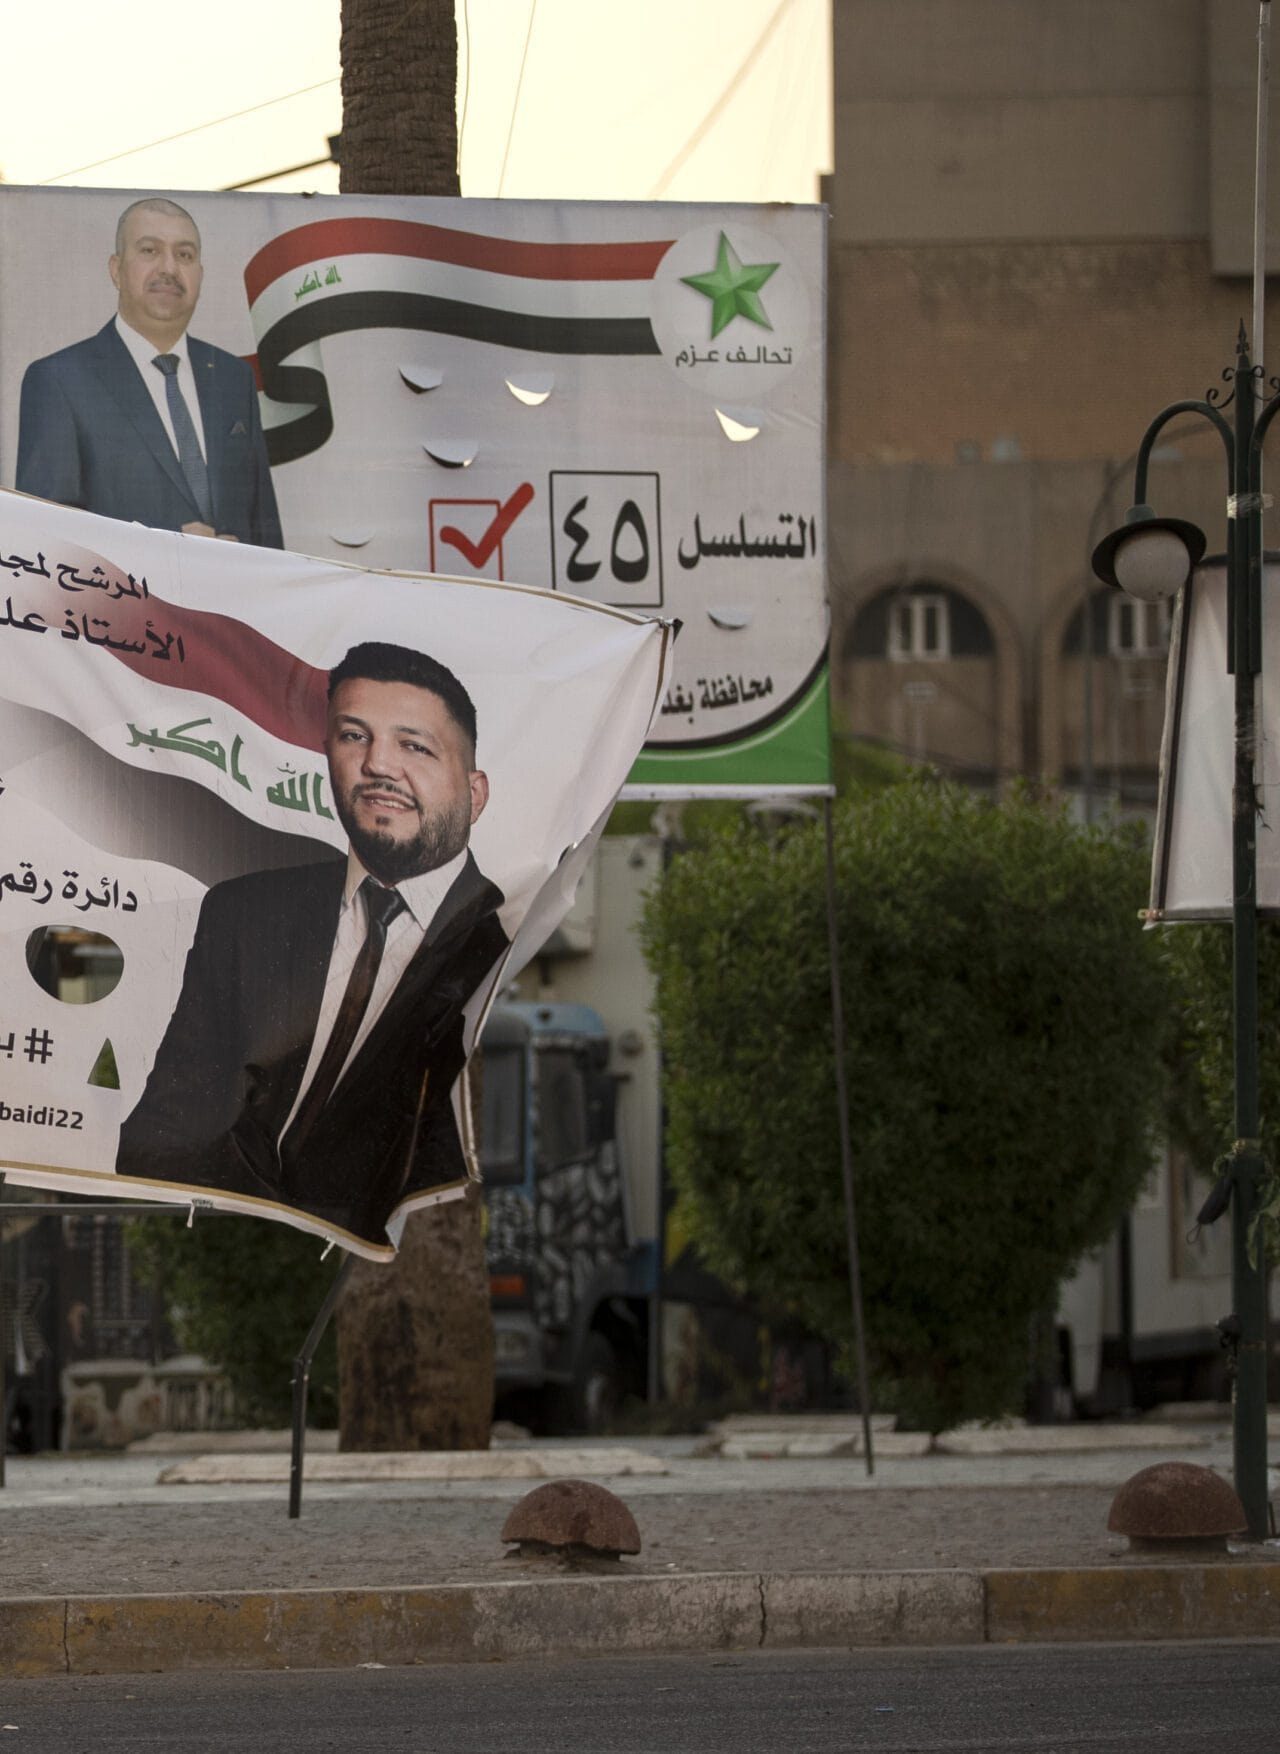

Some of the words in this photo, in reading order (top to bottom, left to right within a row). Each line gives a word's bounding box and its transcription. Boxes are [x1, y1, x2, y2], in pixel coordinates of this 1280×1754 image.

[675, 344, 719, 368] عزم
[726, 345, 792, 364] تحالف
[563, 495, 650, 583] ٤٥
[678, 512, 816, 570] التسلسل
[56, 562, 149, 600] المرشح
[61, 609, 185, 663] الأستاذ
[661, 685, 694, 724] بغد
[697, 674, 773, 709] محافظة
[61, 868, 139, 913] دائرة
